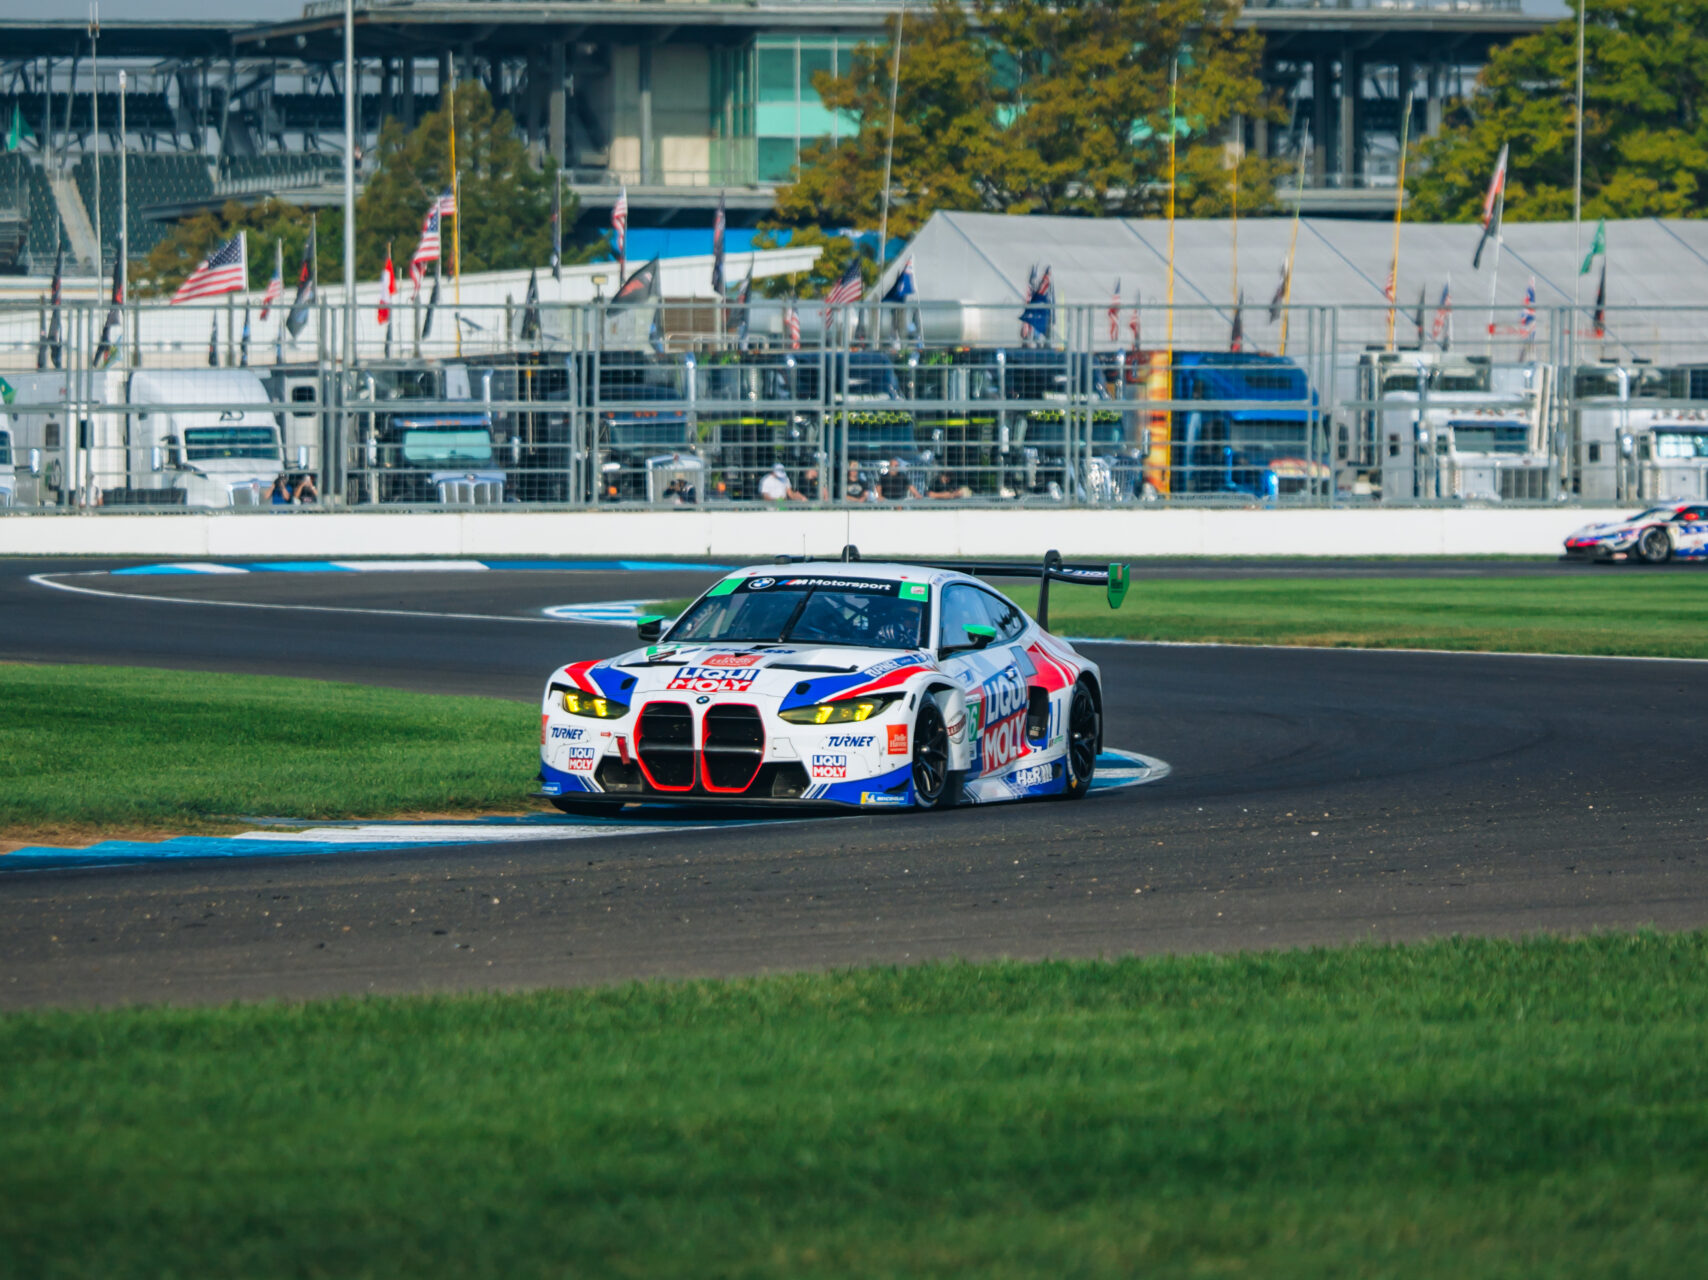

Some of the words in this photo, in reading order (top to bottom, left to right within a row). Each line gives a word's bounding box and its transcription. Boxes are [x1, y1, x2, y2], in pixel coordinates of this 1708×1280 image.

[809, 578, 892, 591] Motorsport
[681, 667, 757, 680] LIQUI
[669, 677, 750, 692] MOLY
[985, 665, 1027, 725] LIQUI
[551, 727, 584, 740] TURNER
[827, 736, 874, 747] TURNER
[983, 711, 1027, 773] MOLY
[570, 748, 594, 758] LIQUI
[570, 759, 593, 769] MOLY
[813, 756, 846, 766] LIQUI
[813, 766, 846, 777] MOLY
[1016, 768, 1040, 786] H&R
